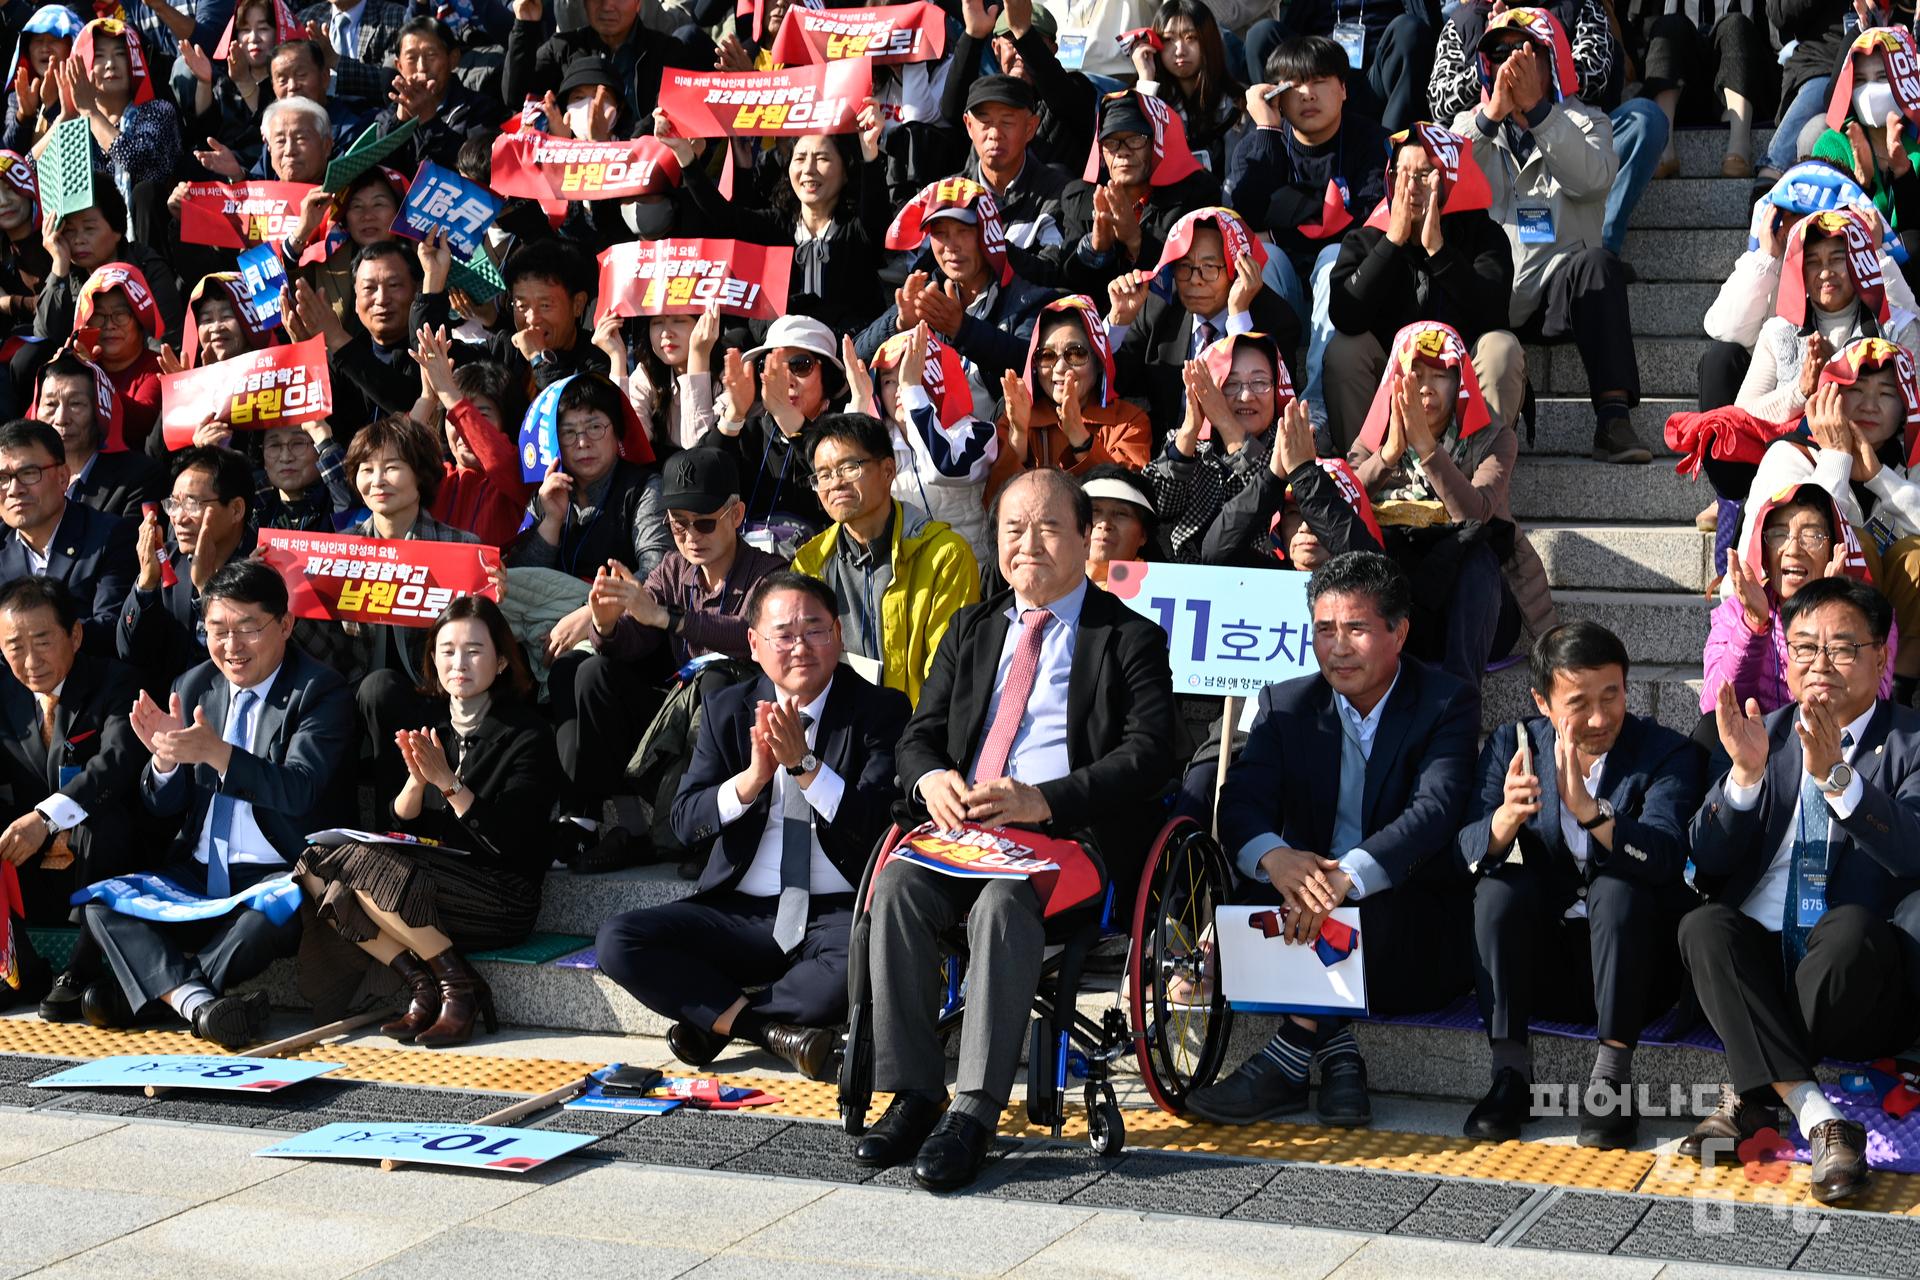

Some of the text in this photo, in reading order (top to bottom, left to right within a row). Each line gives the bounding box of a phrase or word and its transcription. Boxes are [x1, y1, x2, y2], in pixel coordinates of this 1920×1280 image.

[826, 28, 924, 58] 남원으로!
[674, 76, 791, 88] 미래 치안 핵심인재 양성의 요람,
[704, 85, 817, 105] 제2중앙경찰학교
[732, 97, 847, 130] 남원으로!
[533, 147, 635, 164] 제2중앙경찰학교
[561, 158, 658, 192] 남원으로!
[410, 176, 495, 235] 남원!
[678, 246, 698, 258] 요람,
[641, 277, 761, 310] 남원으로!
[270, 537, 399, 560] 미래 치안 핵심인재 양성의 요람,
[303, 556, 429, 585] 제2중앙경찰학교
[1801, 898, 1823, 911] 875
